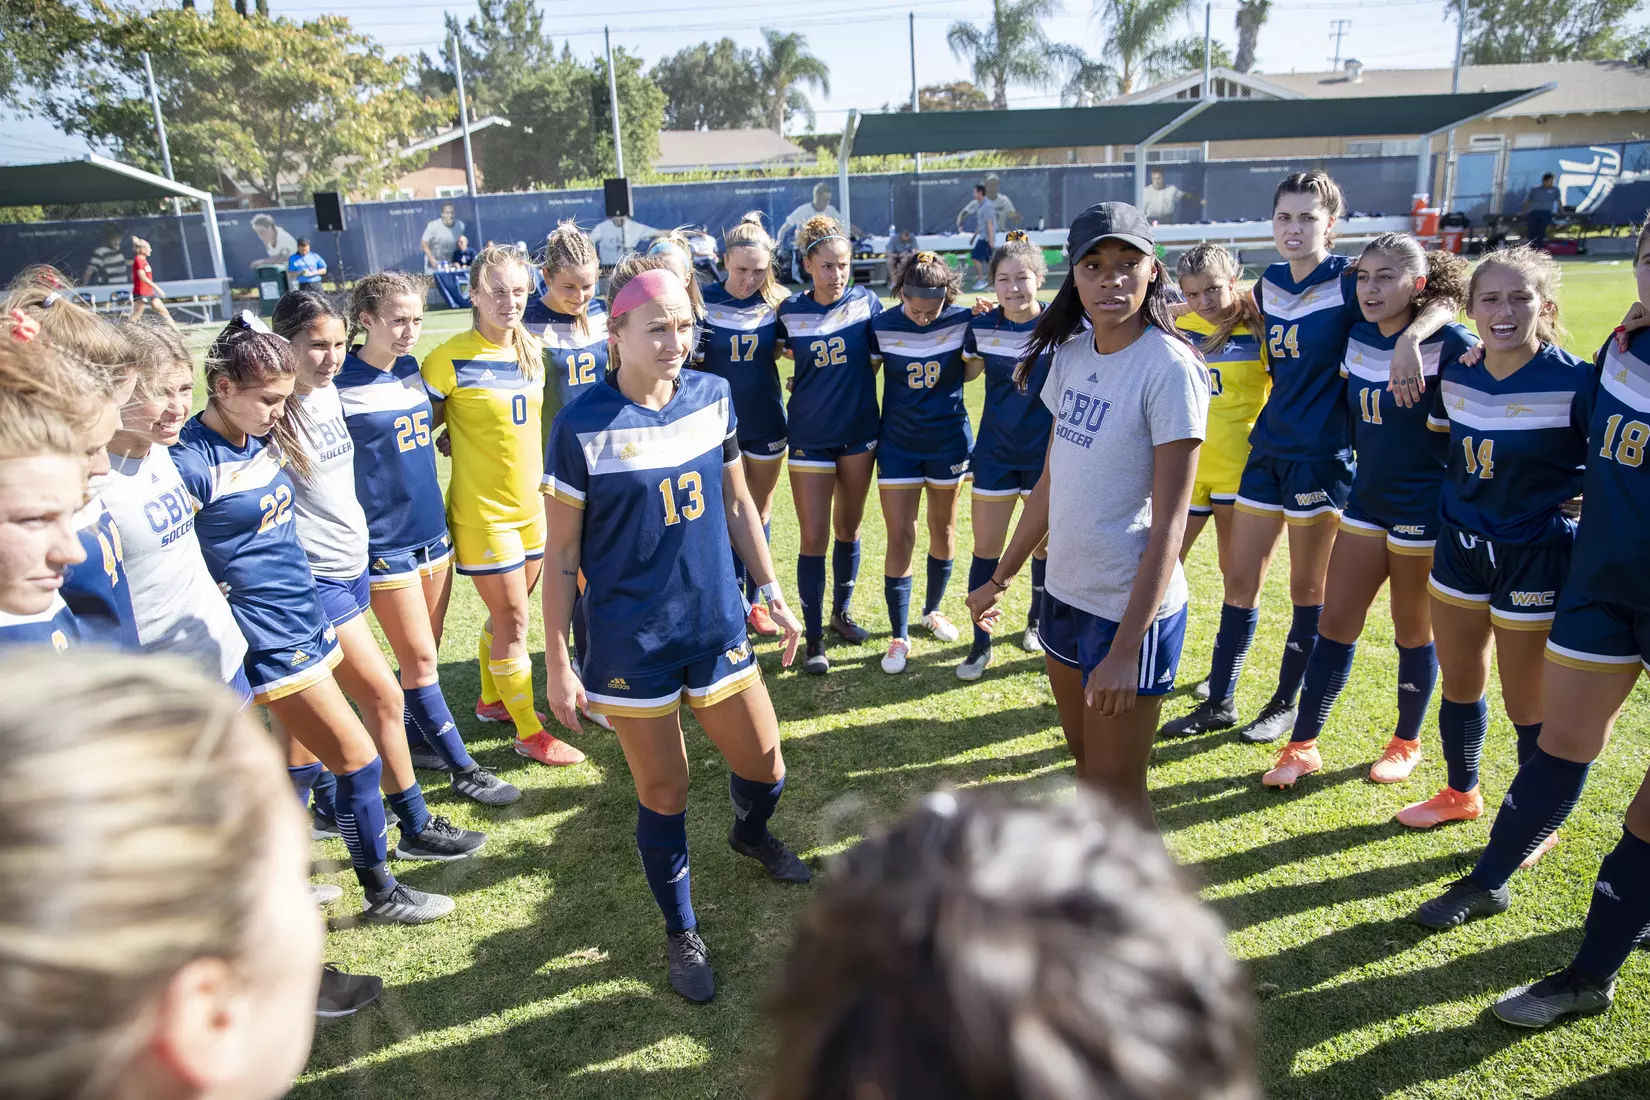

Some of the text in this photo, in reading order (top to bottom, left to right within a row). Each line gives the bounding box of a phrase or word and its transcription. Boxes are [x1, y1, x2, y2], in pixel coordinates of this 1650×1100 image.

[730, 334, 758, 361] 17
[810, 336, 847, 367] 32
[1269, 324, 1300, 358] 24
[566, 352, 596, 386] 12
[907, 361, 940, 389] 28
[511, 394, 527, 426] 0
[1059, 387, 1112, 434] CBU
[1359, 387, 1382, 425] 11
[394, 410, 430, 453] 25
[1056, 425, 1093, 449] SOCCER
[1599, 414, 1650, 467] 18
[320, 442, 352, 463] SOCCER
[1462, 436, 1494, 479] 14
[142, 482, 193, 535] CBU
[257, 484, 292, 534] 22
[659, 471, 705, 526] 13
[1295, 491, 1327, 506] WAC
[1509, 590, 1555, 606] WAC
[608, 682, 630, 690] adidas
